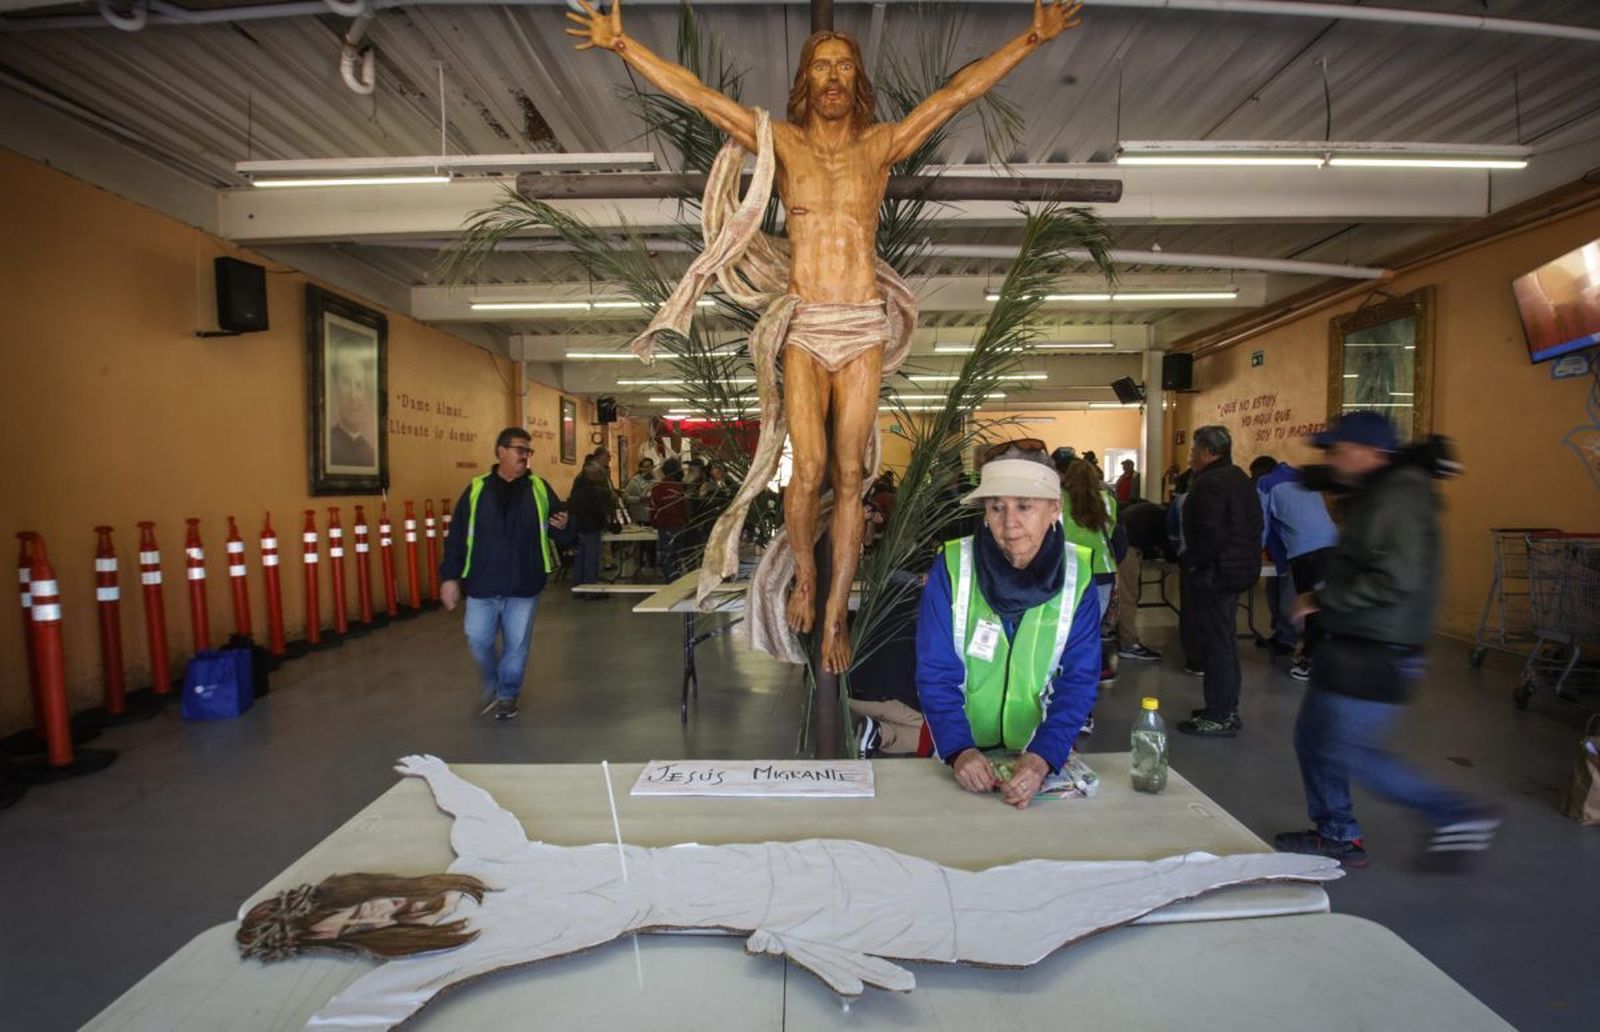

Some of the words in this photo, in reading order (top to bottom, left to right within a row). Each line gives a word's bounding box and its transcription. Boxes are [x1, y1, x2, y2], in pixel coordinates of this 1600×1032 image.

[1239, 399, 1250, 411] NO
[1252, 394, 1277, 409] ESTOY
[1275, 427, 1286, 438] TU
[753, 765, 857, 782] MIGRANTE
